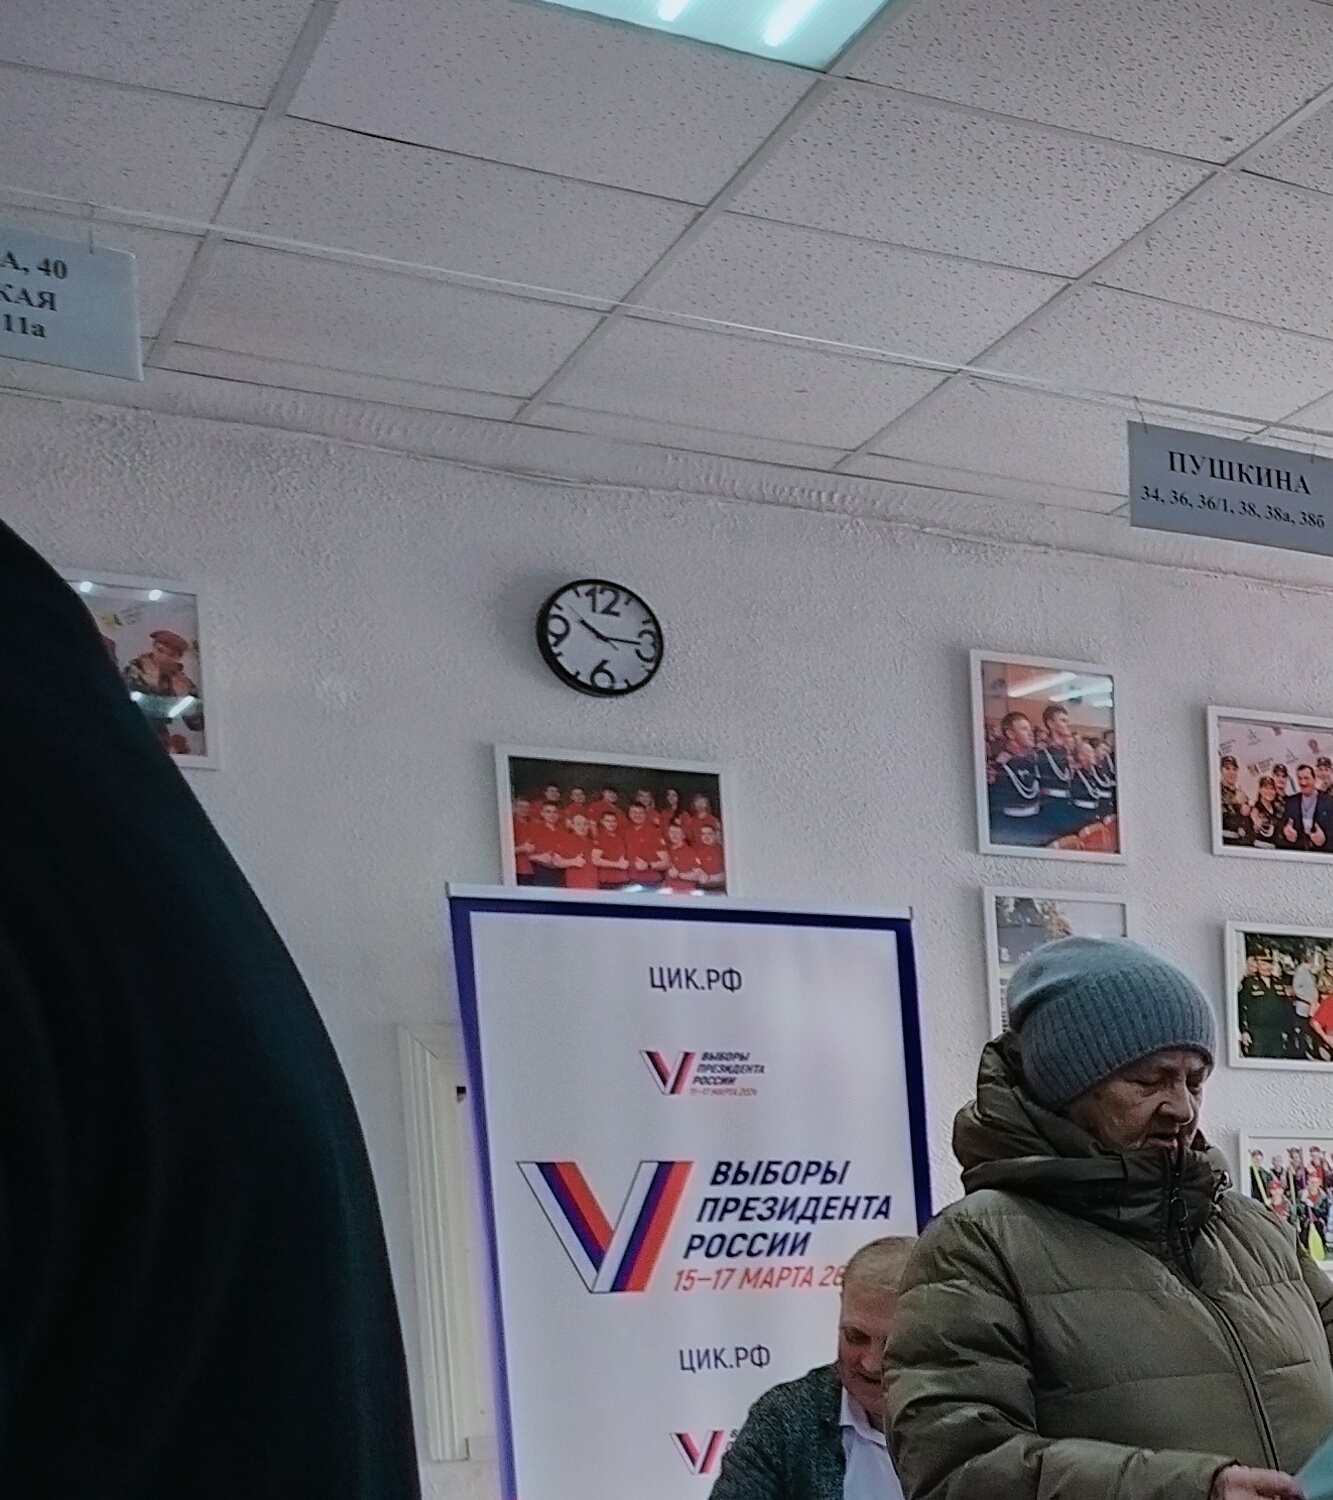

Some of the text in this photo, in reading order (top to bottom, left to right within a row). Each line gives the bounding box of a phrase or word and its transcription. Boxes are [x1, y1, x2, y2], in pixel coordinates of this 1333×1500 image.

[37, 257, 68, 280] 40
[3, 313, 47, 339] 11а
[1168, 450, 1312, 495] ПУШКИНА
[1140, 485, 1326, 529] 34, 36, 36/1, 38, 38а, 38б
[585, 586, 621, 617] 12
[548, 613, 570, 647] 9
[634, 629, 656, 663] 3
[590, 660, 616, 690] 6
[649, 966, 743, 992] ЦИК.РФ
[710, 1159, 851, 1186] ВЫБОРЫ
[696, 1194, 892, 1225] ПРЕЗИДЕНТА
[683, 1232, 811, 1259] РОССИИ
[738, 1265, 815, 1290] МАРТА
[818, 1264, 846, 1288] 20
[679, 1345, 771, 1370] ЦИК.РФ
